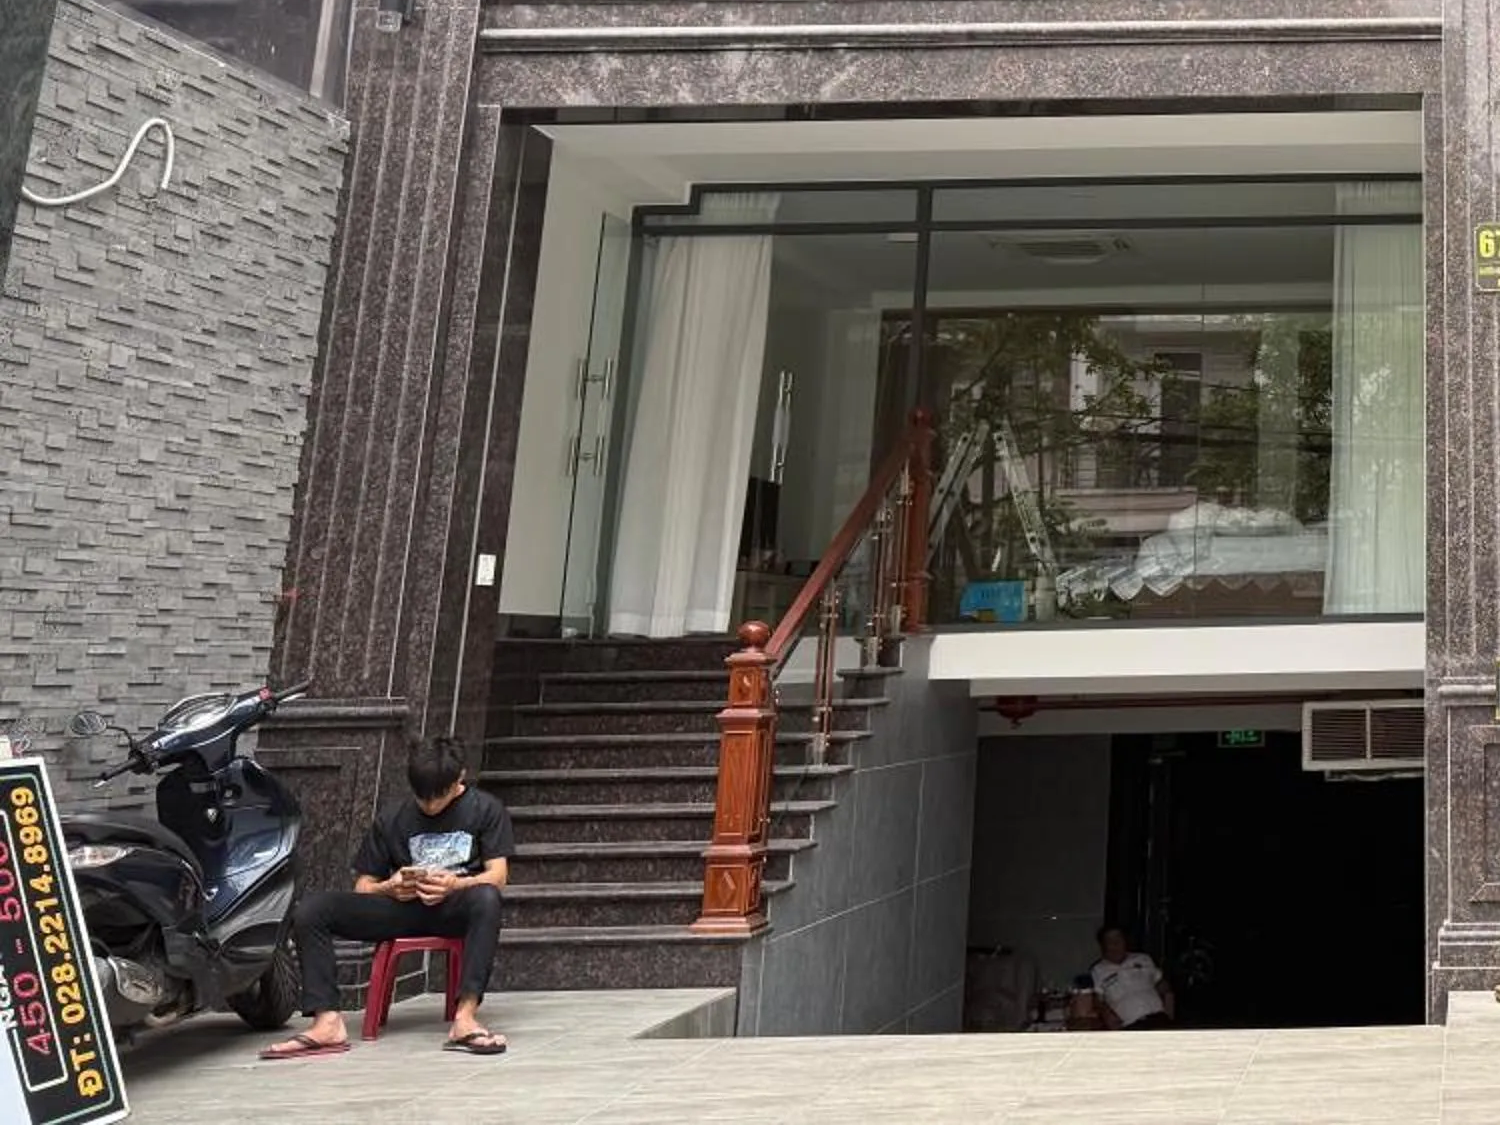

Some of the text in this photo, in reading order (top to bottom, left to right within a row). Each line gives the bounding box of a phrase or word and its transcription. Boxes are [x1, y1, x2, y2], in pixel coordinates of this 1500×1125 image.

[11, 786, 104, 1098] ĐT: 028.2214.8969
[13, 971, 52, 1056] 450
